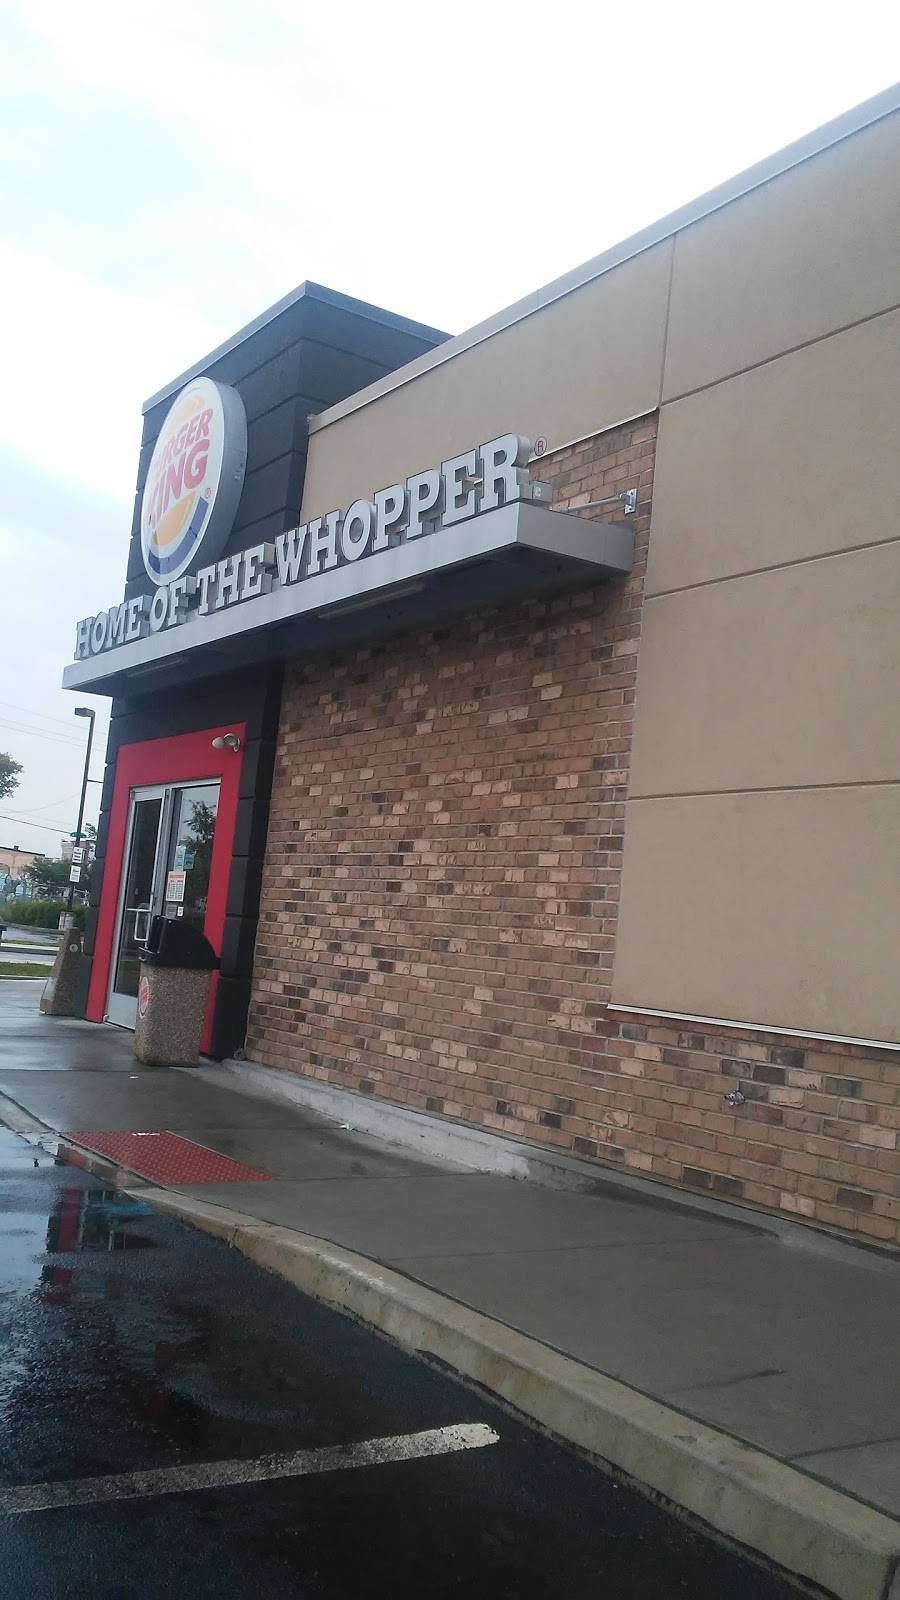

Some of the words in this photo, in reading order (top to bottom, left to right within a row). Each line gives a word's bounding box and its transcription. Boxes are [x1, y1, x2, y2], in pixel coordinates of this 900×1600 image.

[74, 594, 144, 660] HOME
[149, 575, 191, 634] OF
[197, 545, 267, 616] THE
[275, 433, 526, 586] WHOPPER
[148, 438, 210, 530] KING
